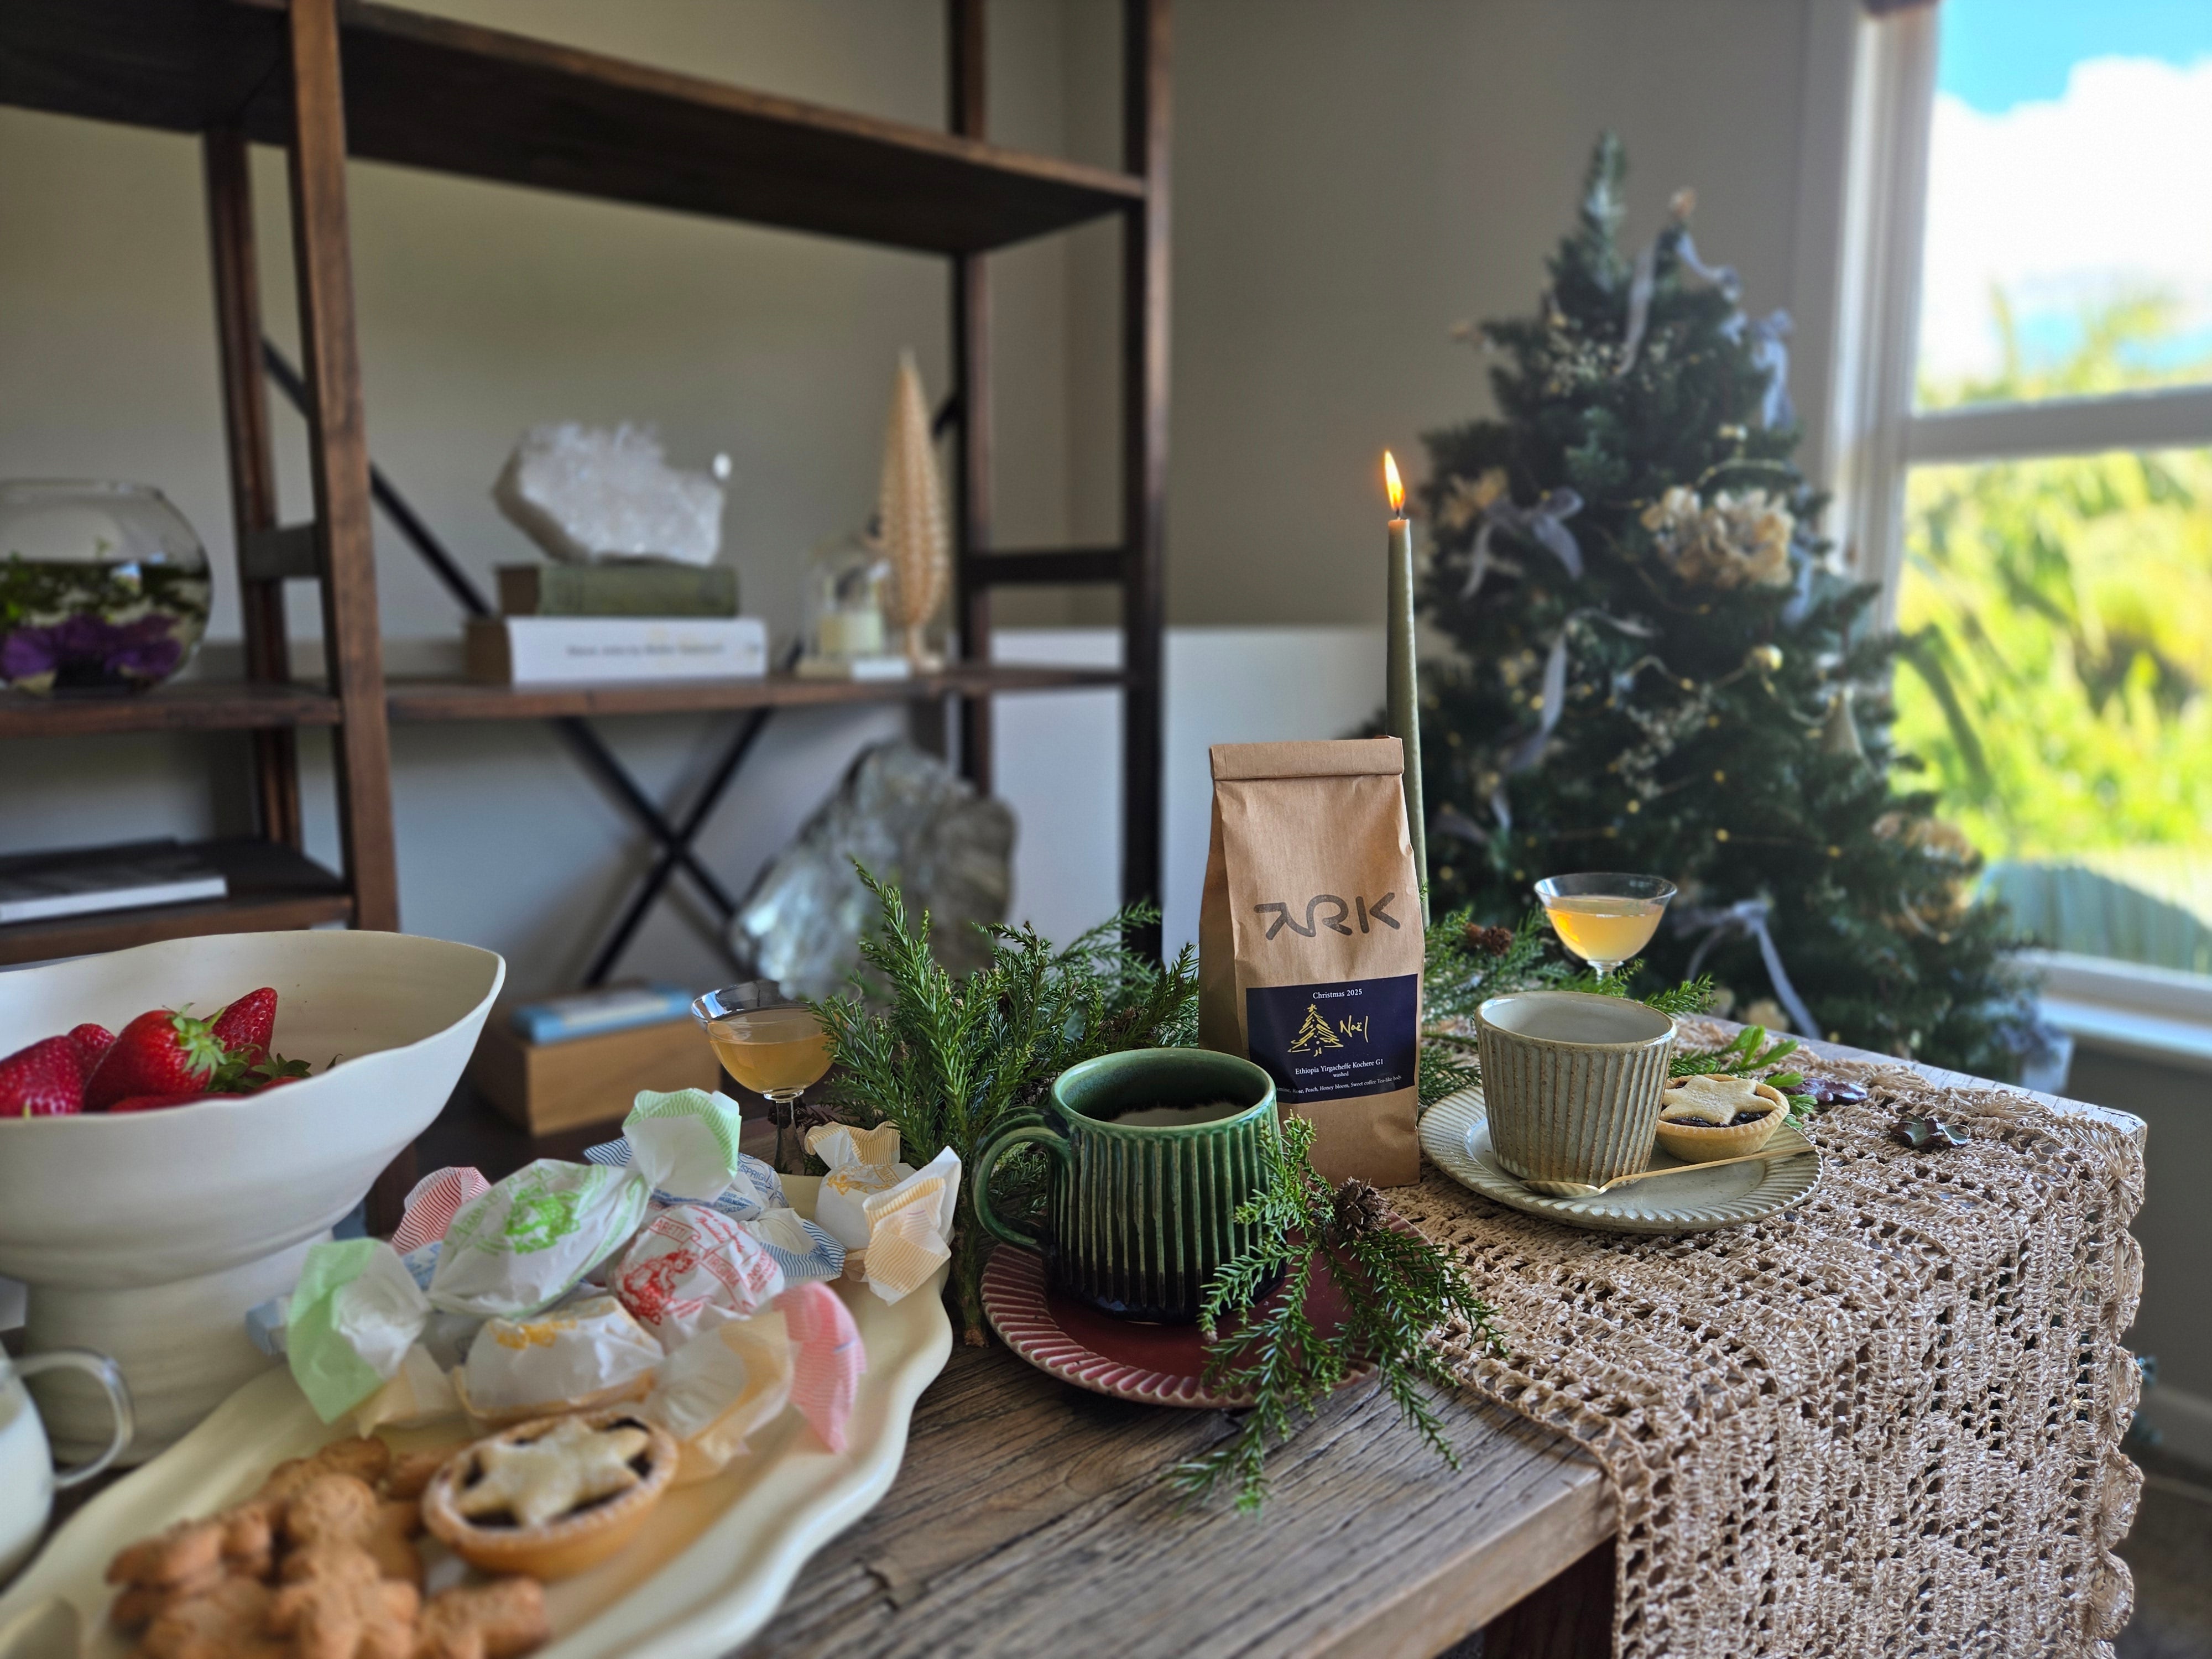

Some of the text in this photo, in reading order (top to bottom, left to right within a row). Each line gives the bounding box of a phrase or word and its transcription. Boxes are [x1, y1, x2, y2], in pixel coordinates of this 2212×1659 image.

[1254, 892, 1401, 940] ARK
[1339, 1015, 1369, 1043] Noël
[1321, 1063, 1351, 1073] Yirgacheffe
[1353, 1060, 1374, 1068] Kochere
